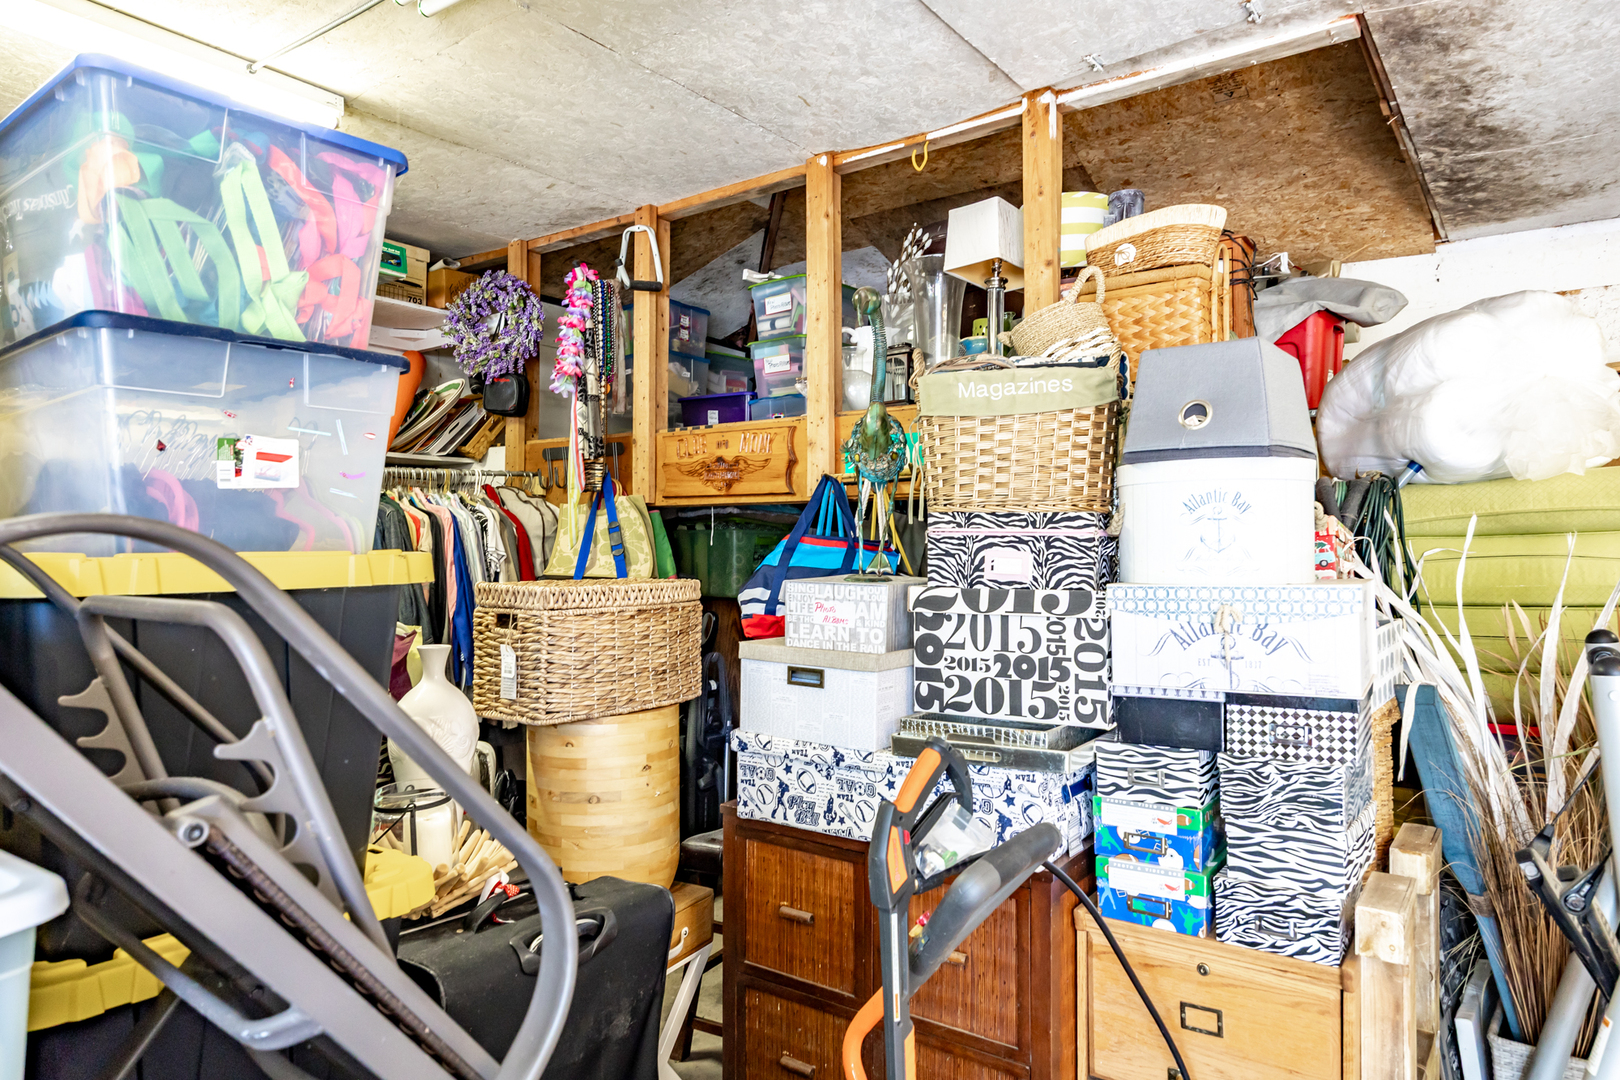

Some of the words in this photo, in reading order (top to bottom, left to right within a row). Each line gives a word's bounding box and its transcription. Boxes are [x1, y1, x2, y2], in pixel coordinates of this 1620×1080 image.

[408, 296, 423, 305] 703
[958, 377, 1073, 400] Magazines
[1182, 487, 1228, 514] Atlantic
[1231, 491, 1252, 514] Bay
[787, 582, 815, 593] SING
[815, 583, 867, 600] LAUGH
[868, 586, 886, 594] OUT
[788, 594, 814, 602] ENJOY
[788, 603, 814, 613] LIFE
[865, 620, 885, 628] KIND
[788, 623, 850, 642] LEARN
[856, 628, 884, 645] TO
[944, 614, 1042, 654] 2015
[1251, 623, 1289, 656] Bay
[787, 638, 820, 649] DANCE
[823, 641, 834, 650] IN
[836, 641, 858, 652] THE
[860, 644, 886, 655] RAIN
[944, 656, 991, 673] 2015
[993, 653, 1072, 682] 2015
[1073, 618, 1108, 725] 2015
[943, 674, 1060, 720] 2015
[1058, 685, 1070, 721] 2015
[791, 748, 809, 758] TEAM
[739, 763, 776, 782] GOAL
[1015, 773, 1036, 783] TEAM
[740, 778, 756, 787] TEAM
[836, 777, 877, 798] GOAL
[836, 793, 854, 802] TEAM
[1113, 862, 1134, 870] PHOTO
[1145, 867, 1165, 875] VIDEO
